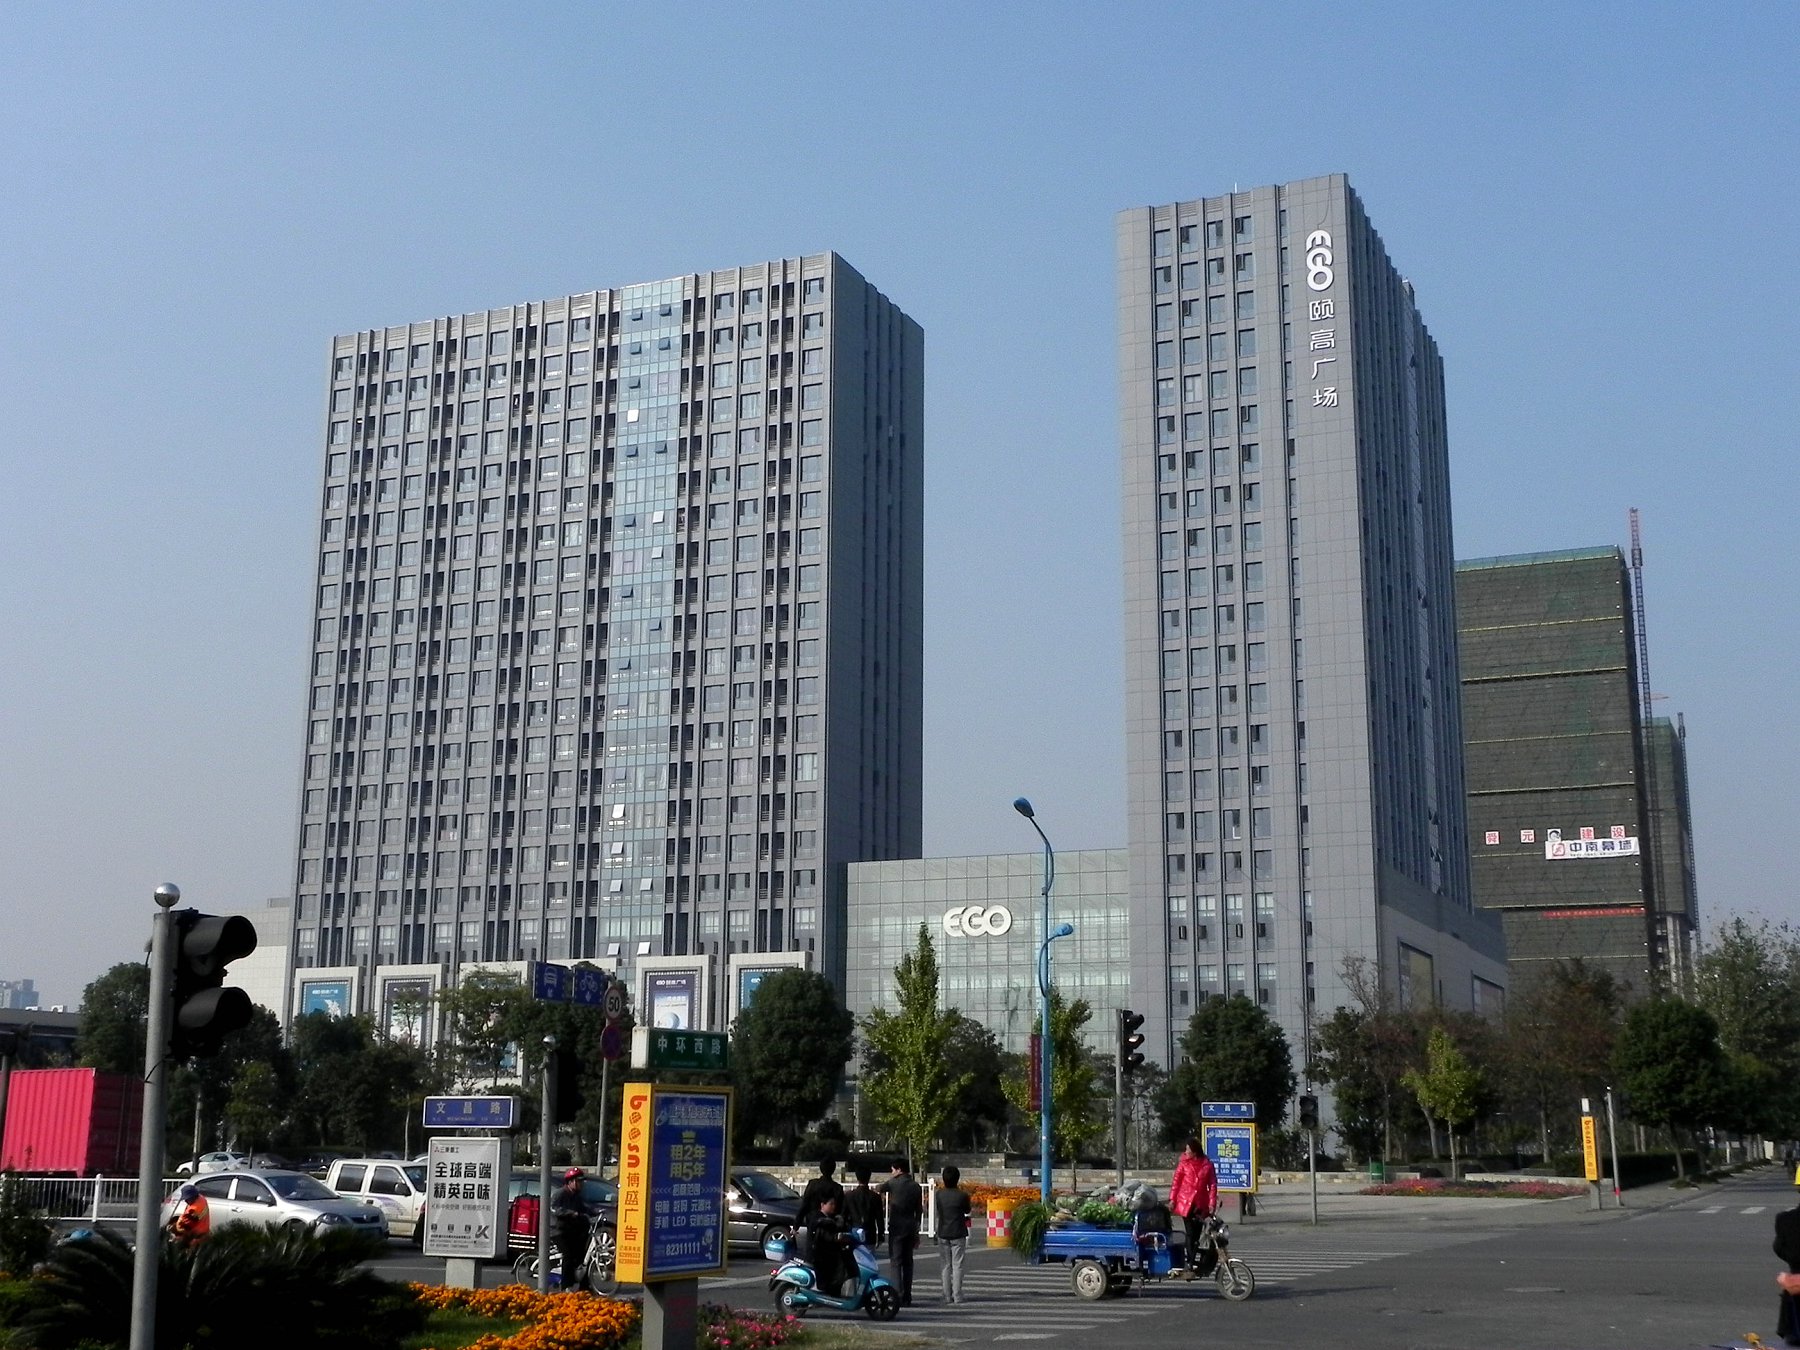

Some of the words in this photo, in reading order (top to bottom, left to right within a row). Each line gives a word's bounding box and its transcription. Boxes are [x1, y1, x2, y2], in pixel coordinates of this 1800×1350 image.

[1309, 299, 1338, 407] 颐高广场
[1569, 840, 1632, 852] 中南幕墙
[607, 996, 620, 1013] 50
[657, 1035, 721, 1055] 中环西路
[435, 1102, 501, 1114] 文昌路
[671, 1144, 706, 1160] 租2年
[435, 1162, 492, 1179] 全球高端
[670, 1161, 705, 1181] 用5年
[434, 1183, 490, 1200] 精英品味
[624, 1172, 641, 1242] 博盛广告
[654, 1215, 669, 1229] 手机
[672, 1216, 687, 1227] LED
[665, 1241, 700, 1256] 82311111
